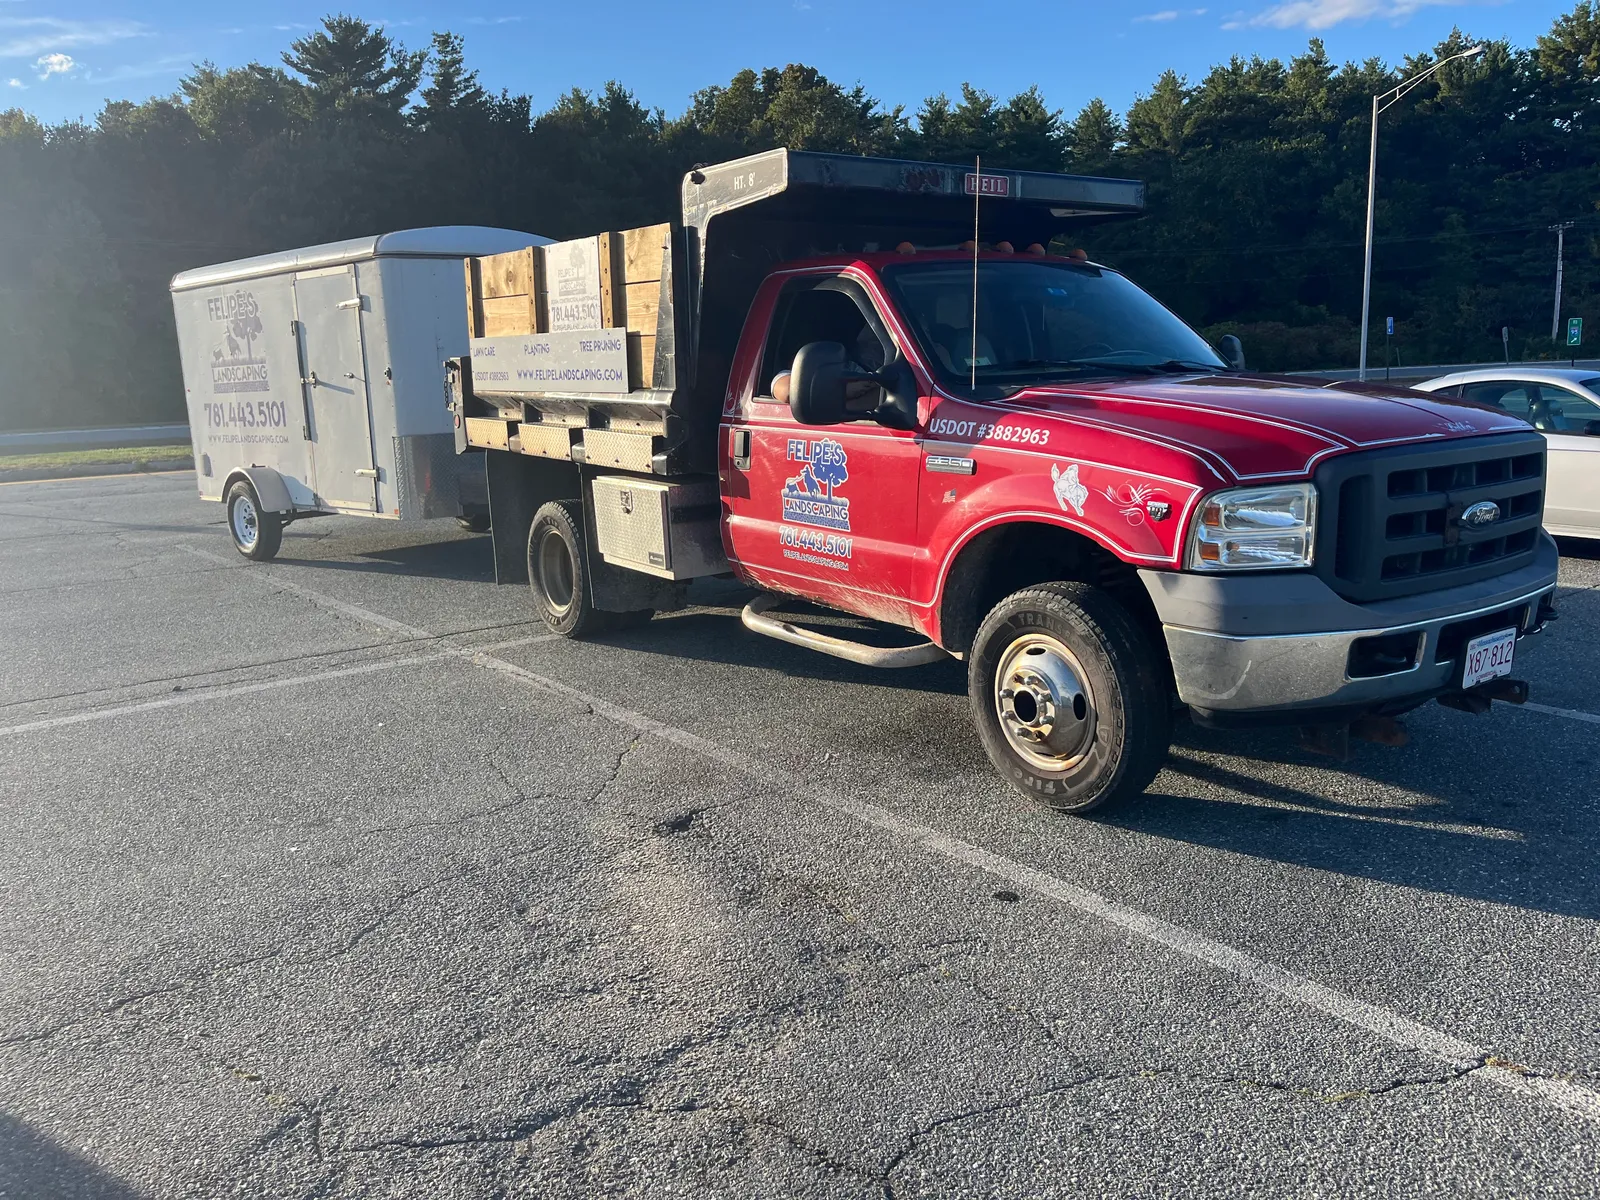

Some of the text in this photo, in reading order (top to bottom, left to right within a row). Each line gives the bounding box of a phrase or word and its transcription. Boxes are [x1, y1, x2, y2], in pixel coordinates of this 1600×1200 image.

[734, 175, 746, 190] HT.
[971, 177, 1004, 192] HEIL
[207, 291, 255, 321] FELIPE'S
[485, 346, 496, 356] CARE
[524, 343, 550, 356] PLANTING
[579, 339, 621, 352] TREE PRUNING
[212, 365, 267, 383] LANDSCAPING
[516, 368, 623, 381] WWW.FELIPELANDSCAPING.COM
[204, 401, 287, 428] 781.443.5101
[929, 418, 1050, 446] USDOT #3882963
[786, 439, 843, 465] FELIPE'S
[783, 498, 848, 520] LANDSCAPING
[1474, 508, 1496, 523] Ford
[779, 526, 853, 559] 781.443.5101
